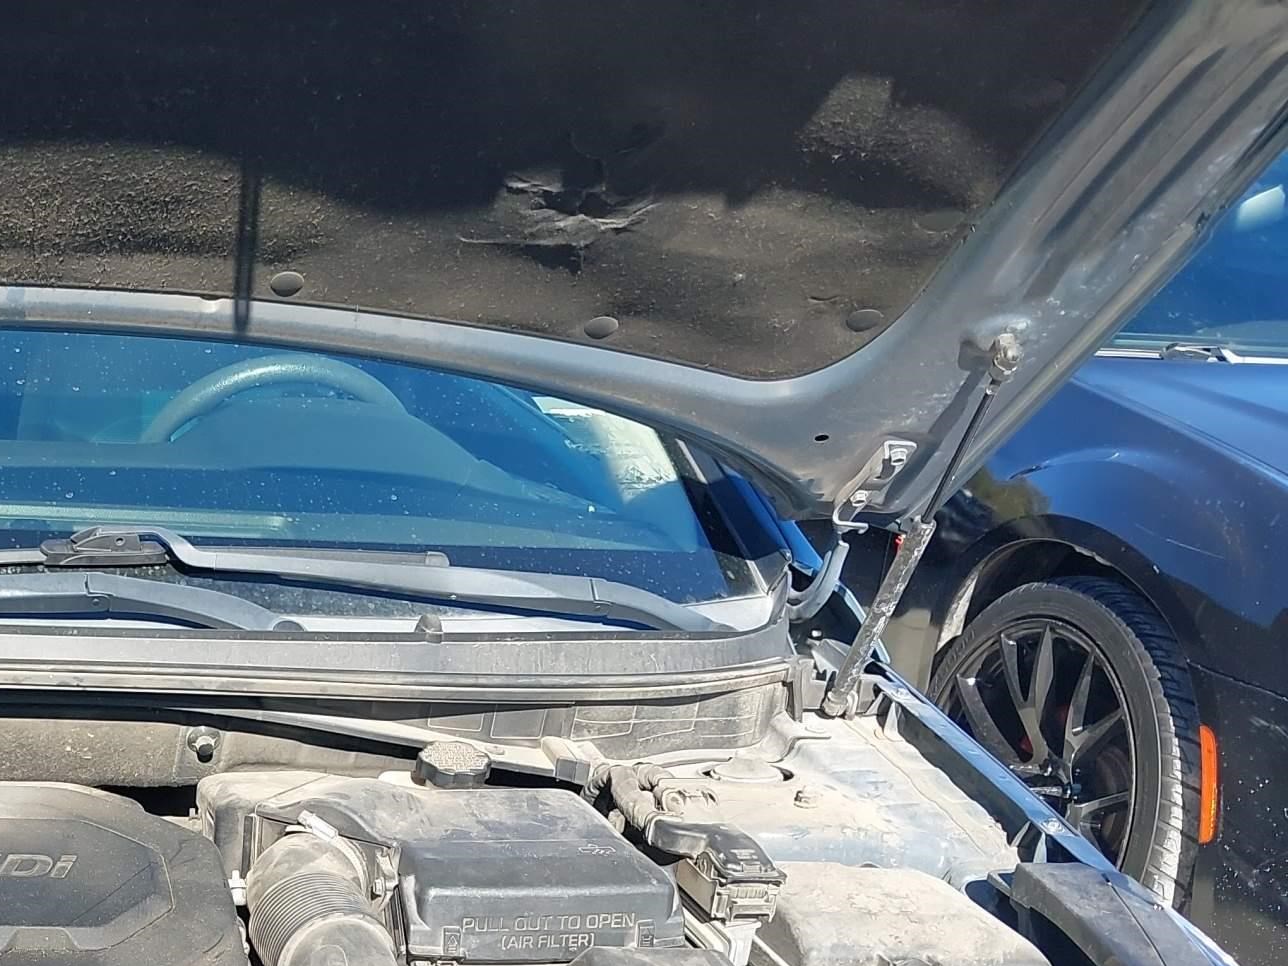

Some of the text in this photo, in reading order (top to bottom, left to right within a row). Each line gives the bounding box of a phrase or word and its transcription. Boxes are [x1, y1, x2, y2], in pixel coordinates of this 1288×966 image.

[462, 912, 636, 932] PULL OUT TO OPEN
